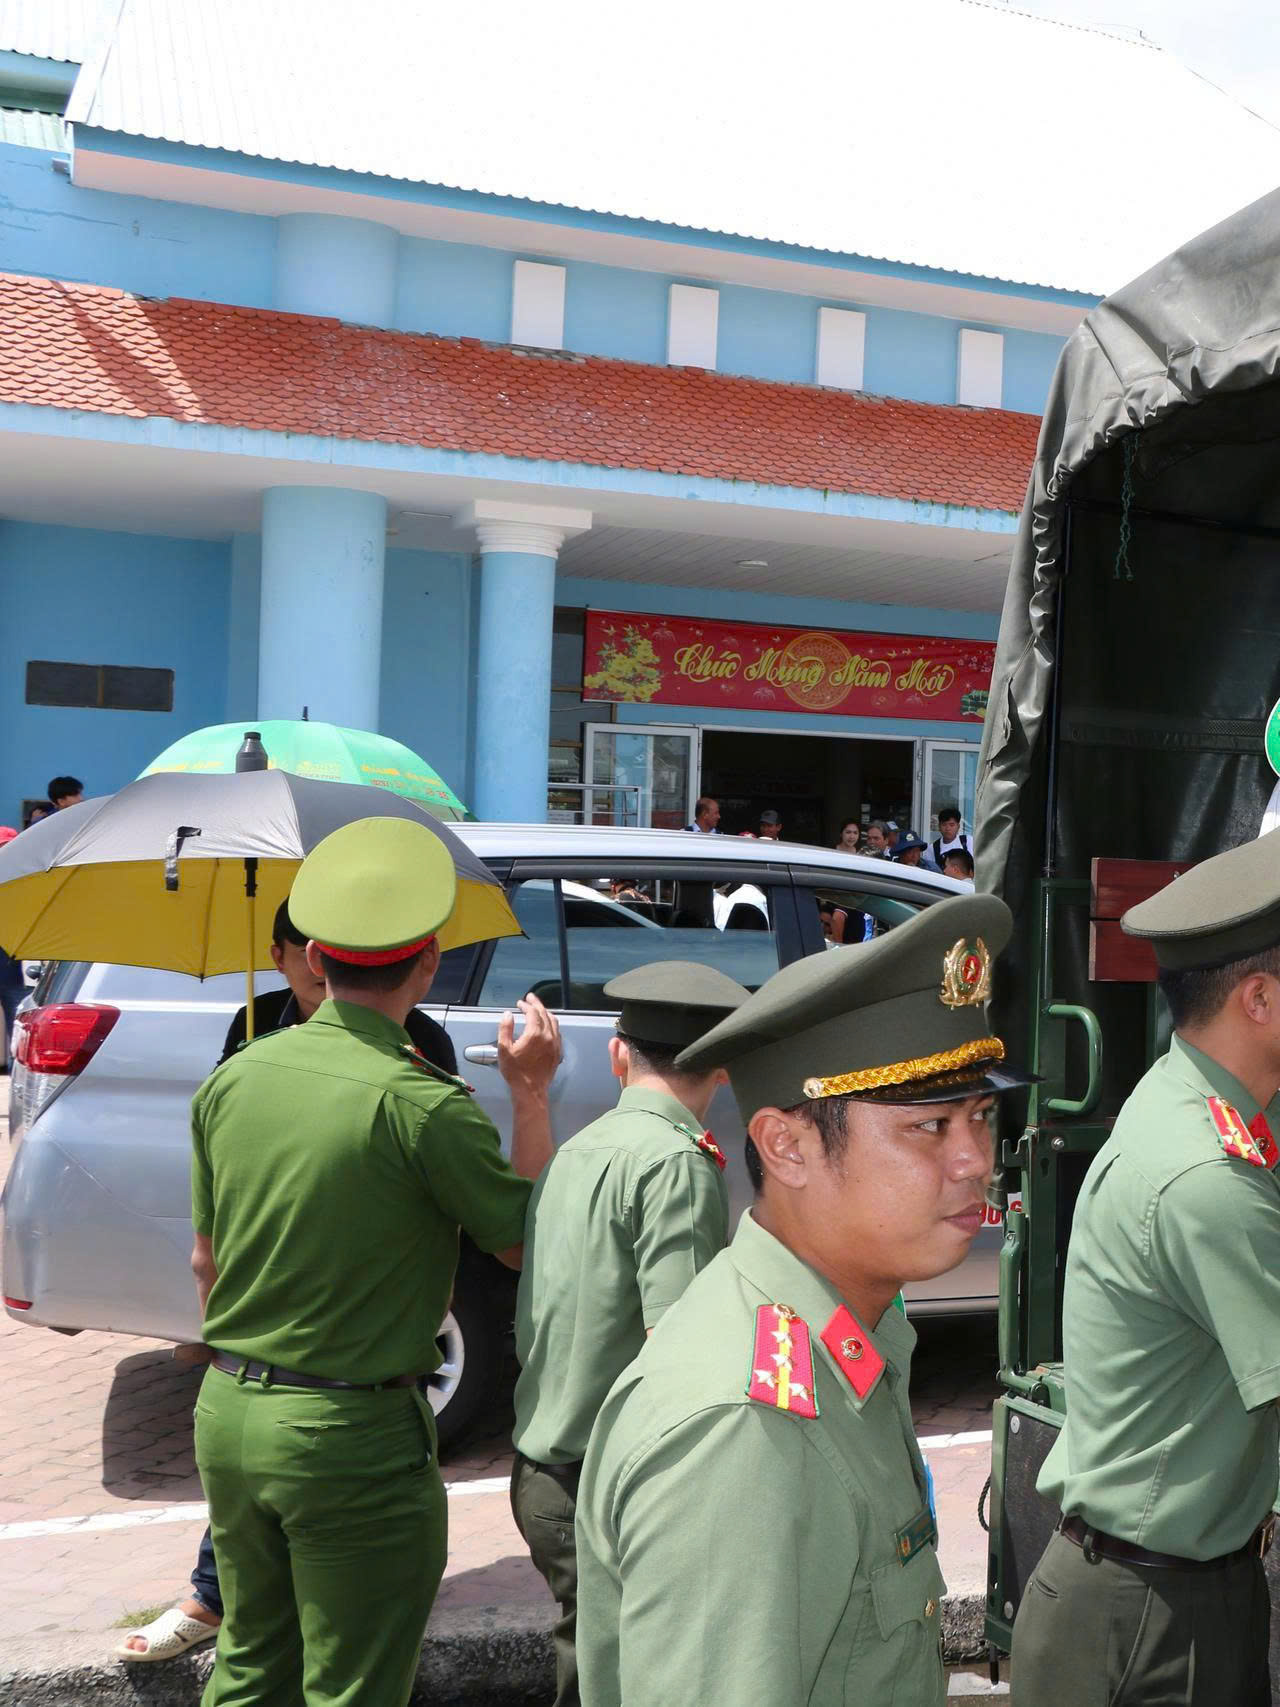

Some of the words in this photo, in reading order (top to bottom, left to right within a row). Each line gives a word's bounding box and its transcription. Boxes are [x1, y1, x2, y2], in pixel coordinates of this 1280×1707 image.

[674, 643, 742, 682] Chúc
[744, 648, 826, 692] Mừng
[829, 655, 892, 689] Năm
[895, 658, 955, 697] Mới
